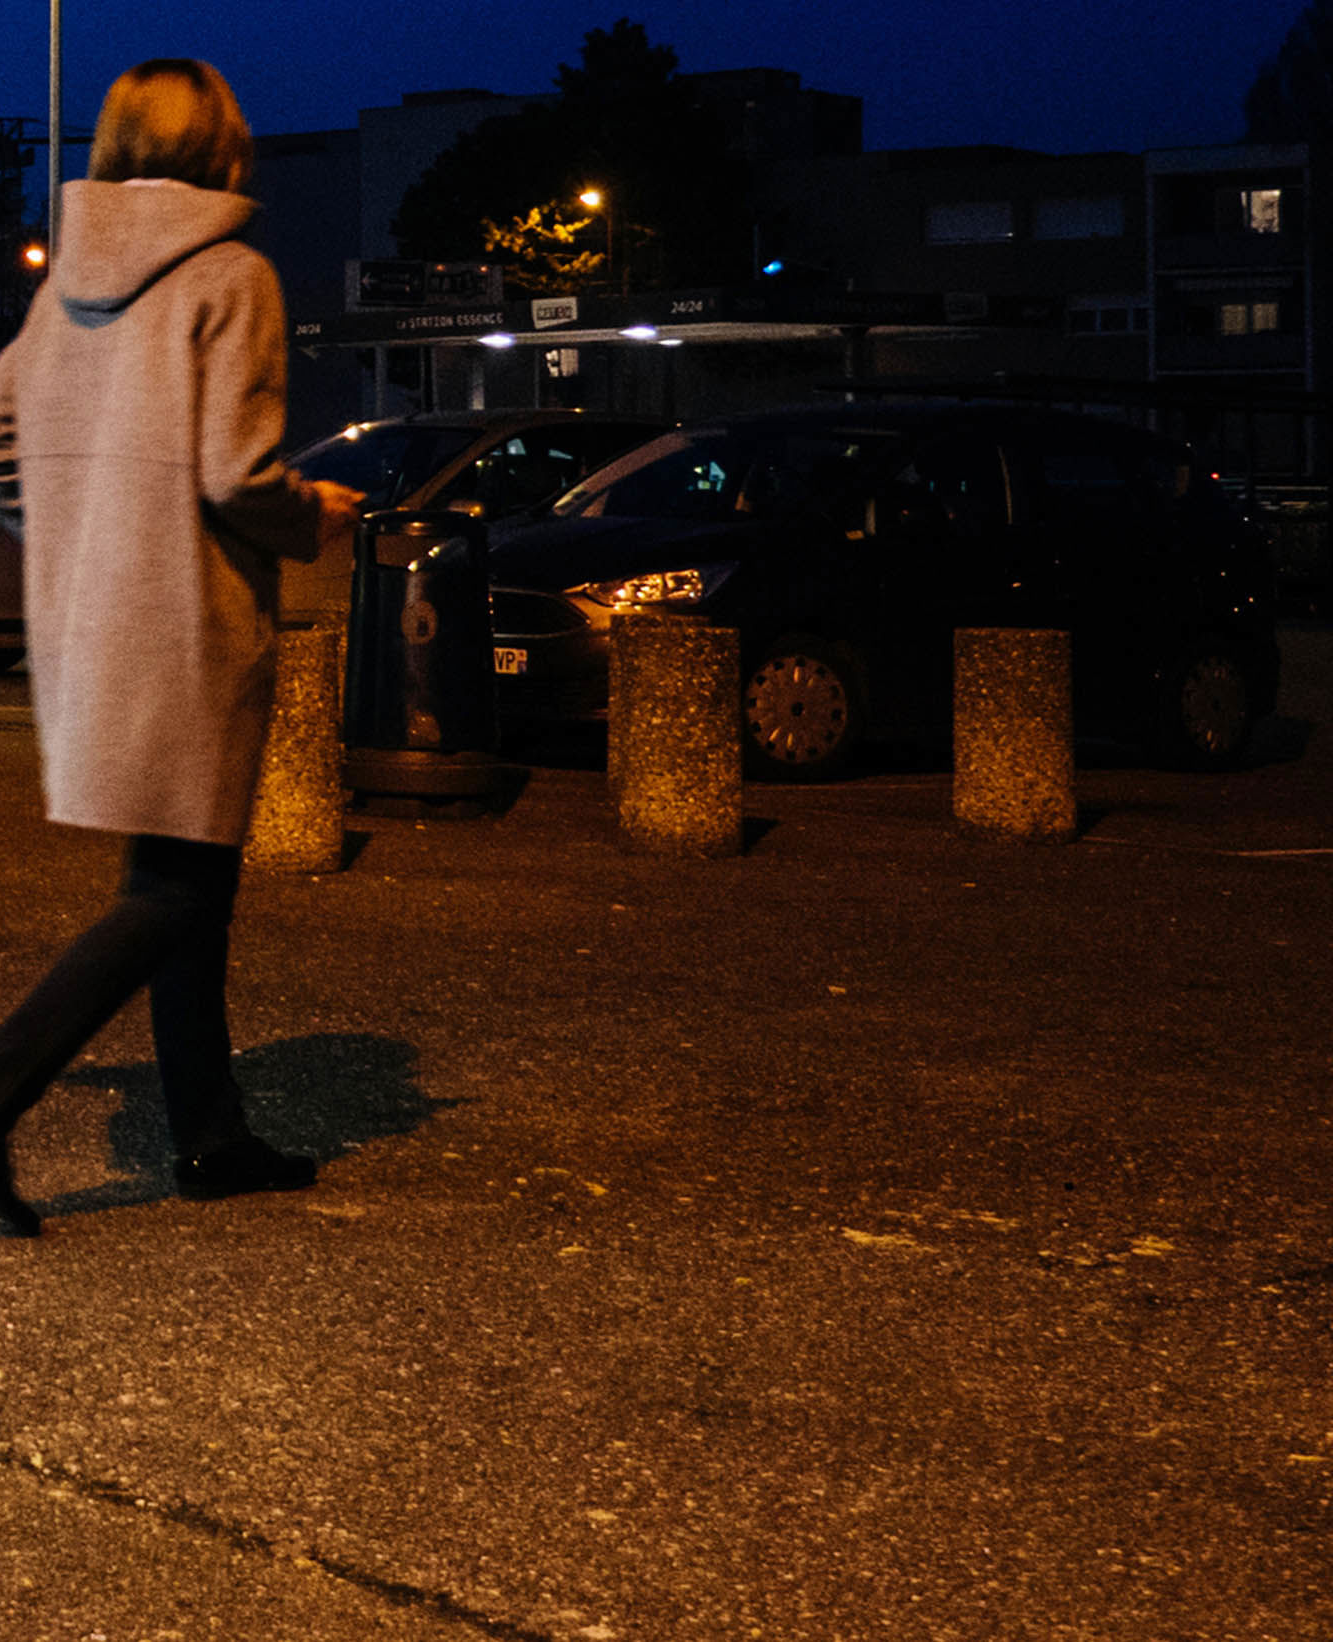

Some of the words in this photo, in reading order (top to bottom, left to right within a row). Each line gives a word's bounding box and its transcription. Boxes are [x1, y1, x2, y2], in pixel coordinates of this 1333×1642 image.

[670, 298, 704, 315] 24/24
[408, 315, 454, 329] STATION
[456, 312, 504, 327] ESSENCE
